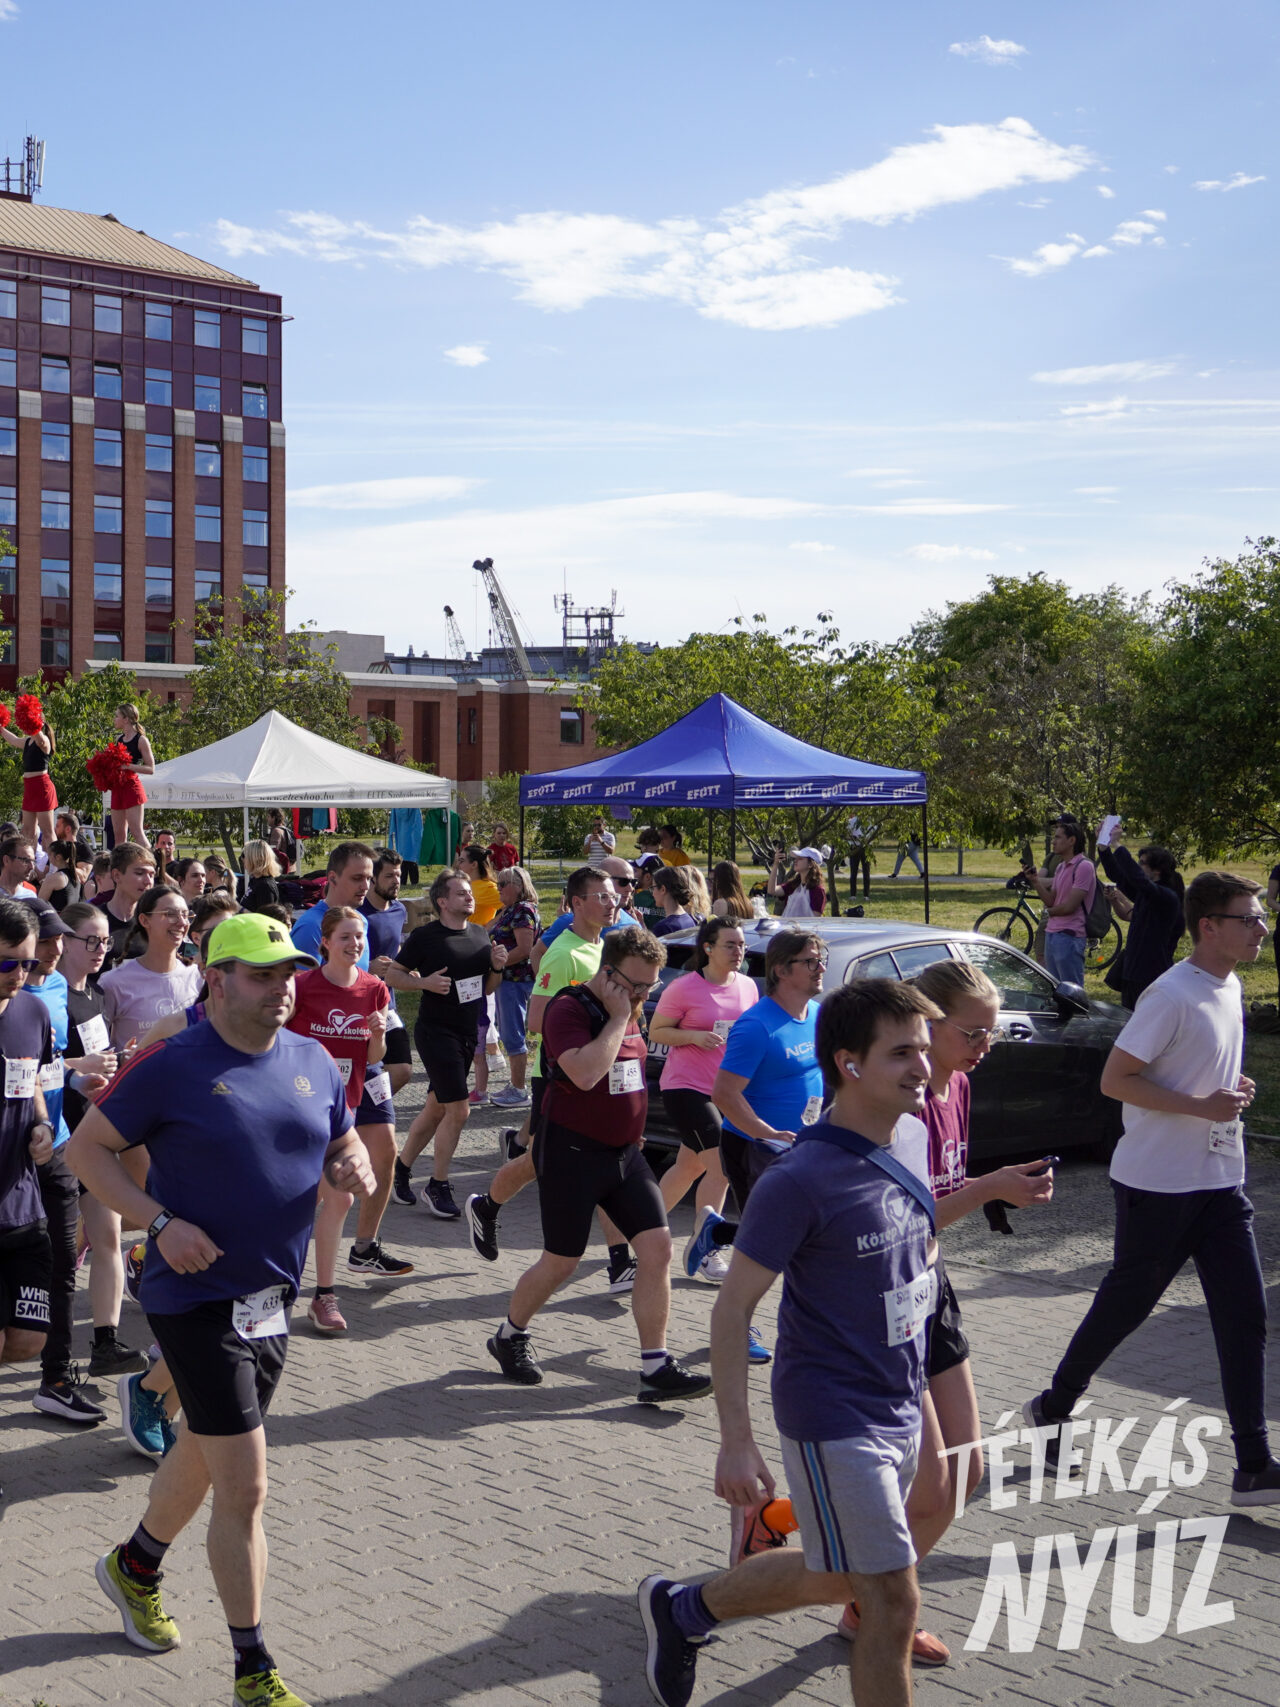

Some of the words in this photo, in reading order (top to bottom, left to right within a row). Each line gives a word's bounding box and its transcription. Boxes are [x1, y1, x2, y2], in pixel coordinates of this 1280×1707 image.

[528, 783, 556, 798] EFOTT
[563, 783, 593, 799] EFOTT
[605, 781, 637, 797] EFOTT
[645, 780, 677, 798] EFOTT
[687, 784, 721, 800] EFOTT
[744, 782, 775, 799] EFOTT
[784, 782, 814, 800] EFOTT
[821, 781, 849, 799] EFOTT
[857, 781, 885, 798] EFOTT
[892, 782, 919, 799] EFOTT
[310, 1022, 336, 1035] Közép
[856, 1227, 898, 1251] Közép
[20, 1285, 50, 1305] WHITE
[262, 1295, 279, 1311] 633
